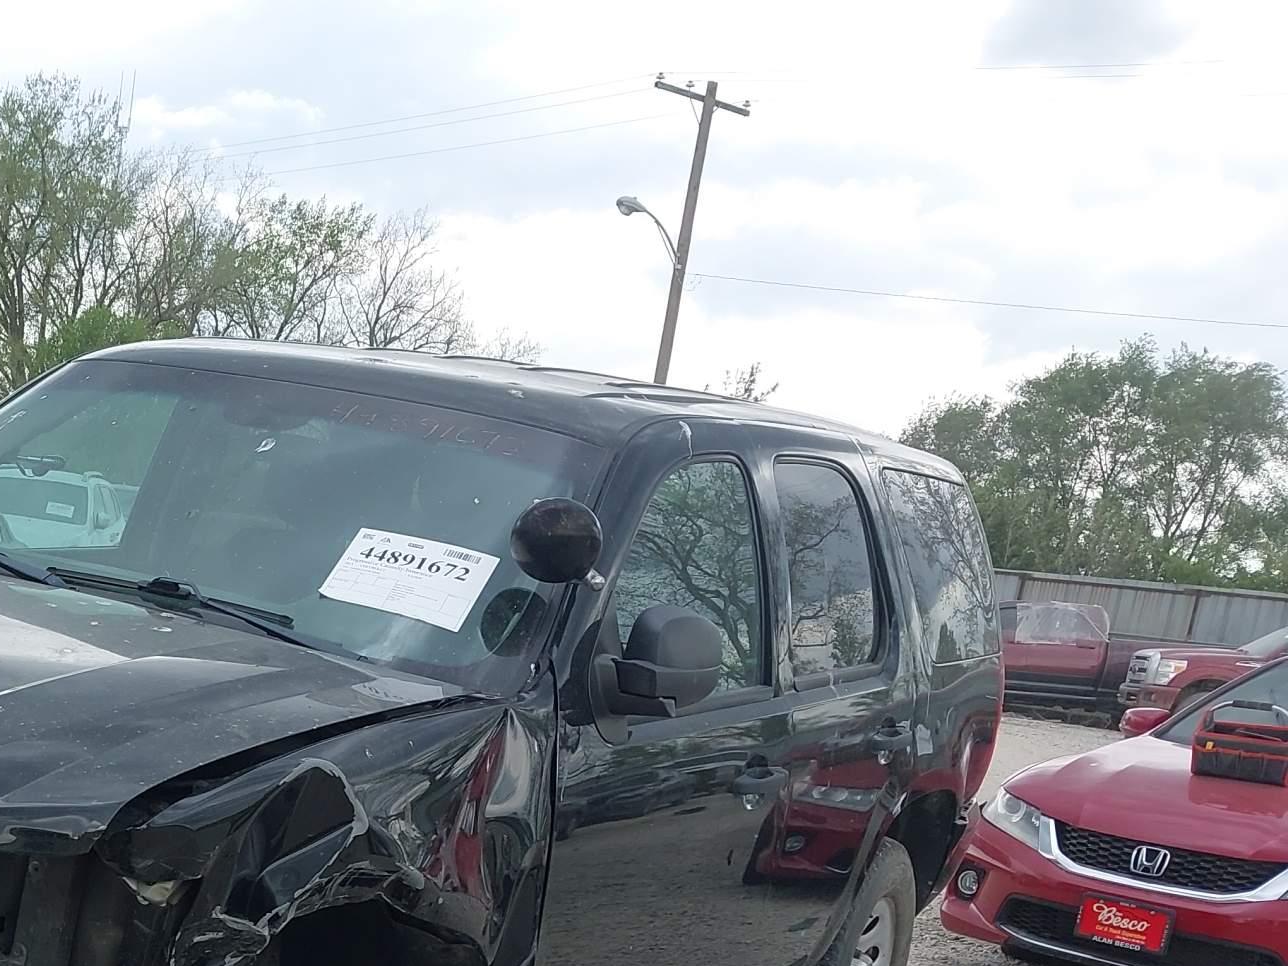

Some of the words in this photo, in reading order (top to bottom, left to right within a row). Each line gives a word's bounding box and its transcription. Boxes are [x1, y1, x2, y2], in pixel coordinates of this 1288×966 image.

[359, 546, 471, 581] 44891672
[1093, 903, 1151, 932] Besco
[1092, 936, 1113, 945] ALAN
[1114, 940, 1141, 951] BESCO
